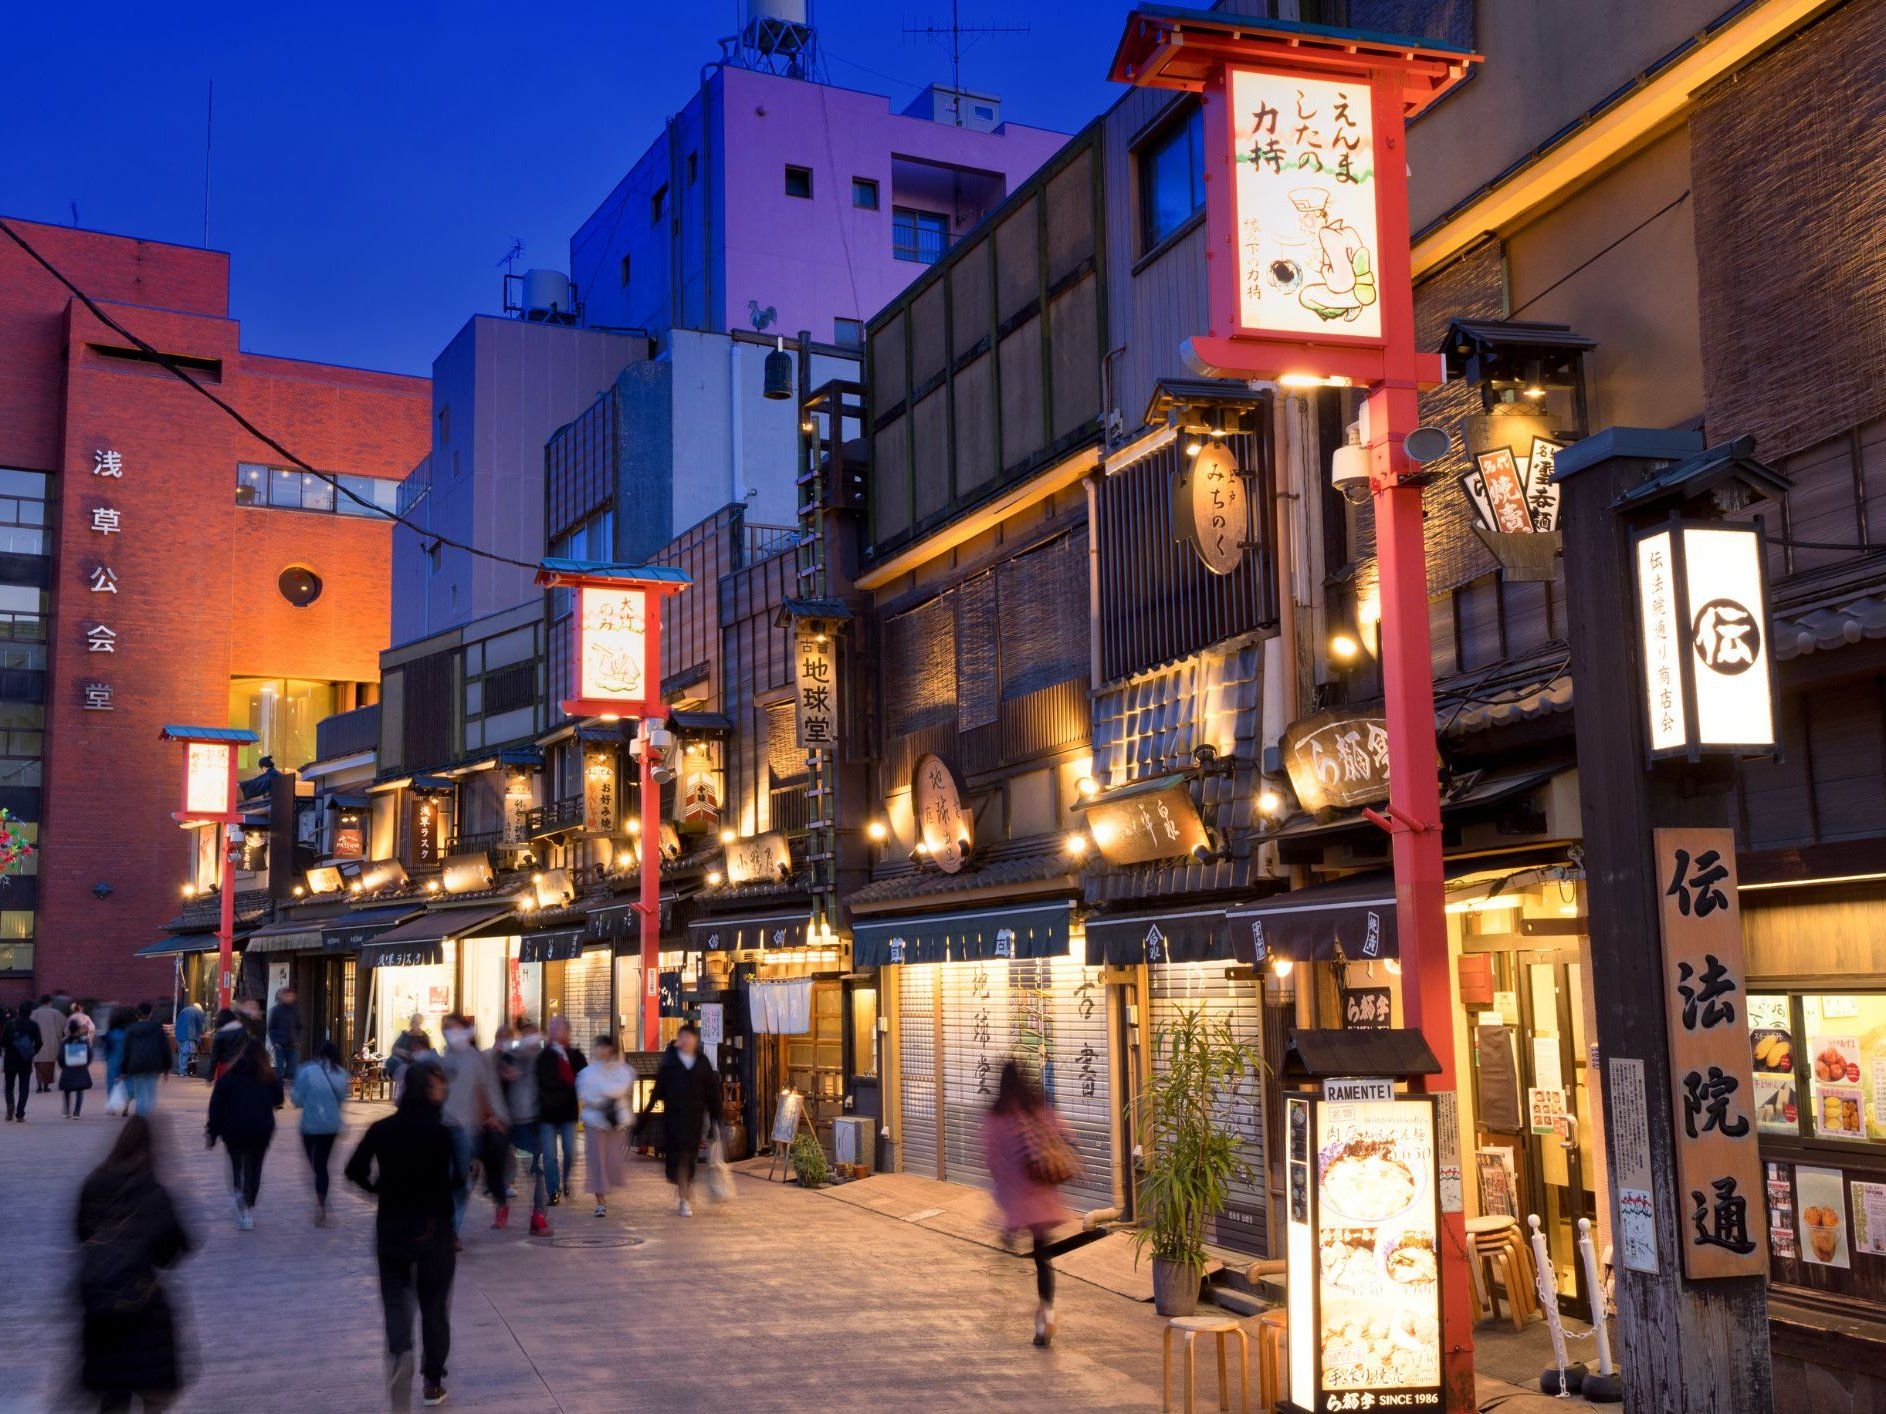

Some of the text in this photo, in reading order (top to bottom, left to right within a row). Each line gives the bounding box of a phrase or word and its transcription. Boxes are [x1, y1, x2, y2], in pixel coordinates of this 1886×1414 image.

[1248, 101, 1286, 175] 力持
[1295, 89, 1323, 173] したの
[1332, 92, 1359, 185] えんま
[1207, 463, 1225, 556] みちのく
[84, 449, 123, 711] 浅草公会堂
[1649, 551, 1675, 733] 伝法院通り商店会
[1695, 605, 1754, 666] 伝
[802, 657, 830, 743] 地球堂
[420, 805, 431, 859] 浅草ラスク
[377, 953, 422, 967] 浅草ラスク
[1328, 1084, 1391, 1101] RAMENTEI
[1666, 848, 1757, 1256] 伝法院通
[1379, 1394, 1413, 1406] SINCE
[1415, 1393, 1438, 1405] 1986
